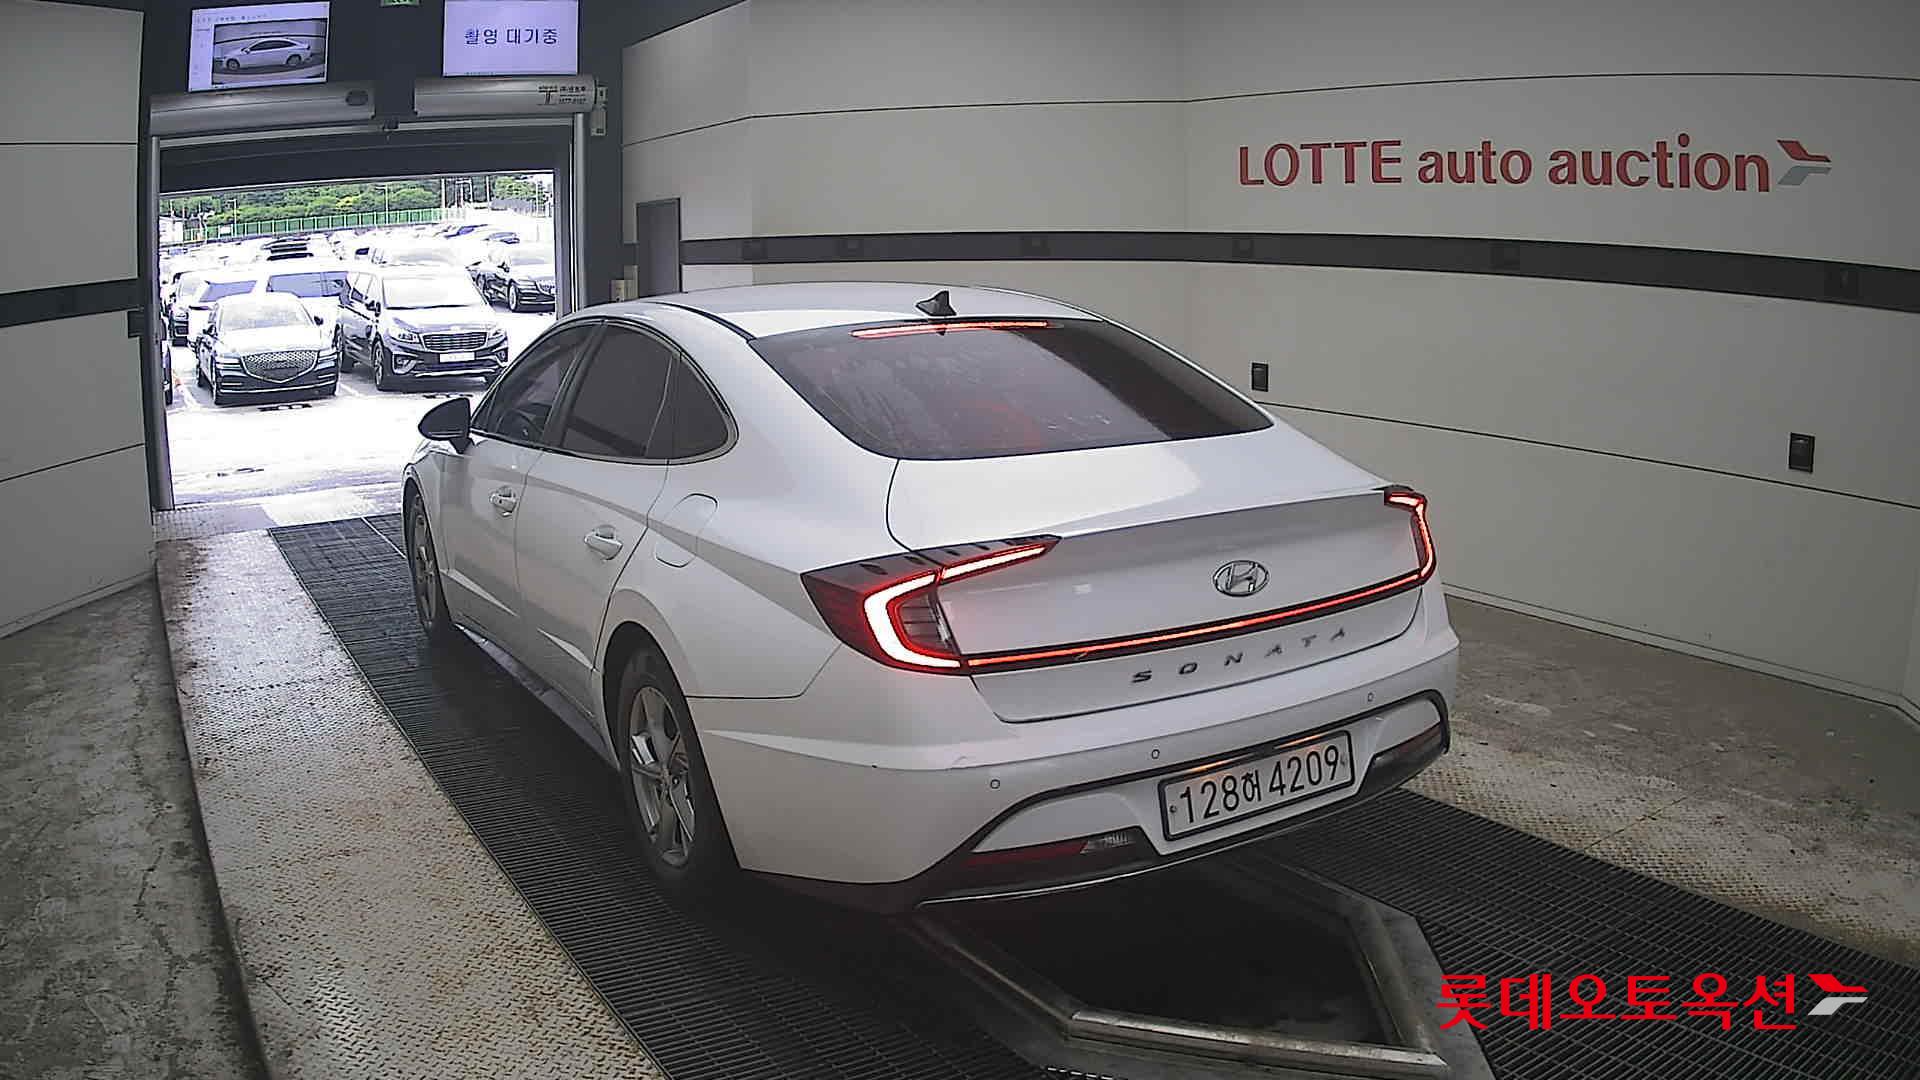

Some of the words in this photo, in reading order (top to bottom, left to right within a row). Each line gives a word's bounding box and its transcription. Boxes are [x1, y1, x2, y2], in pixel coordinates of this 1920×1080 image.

[464, 28, 498, 45] 촬영
[506, 28, 558, 45] 대기중
[1239, 140, 1401, 186] LOTTE
[1417, 140, 1532, 184] auto
[1547, 133, 1770, 192] auction
[1132, 626, 1346, 684] SONATA
[1179, 770, 1262, 823] 128허
[1269, 745, 1339, 796] 4209
